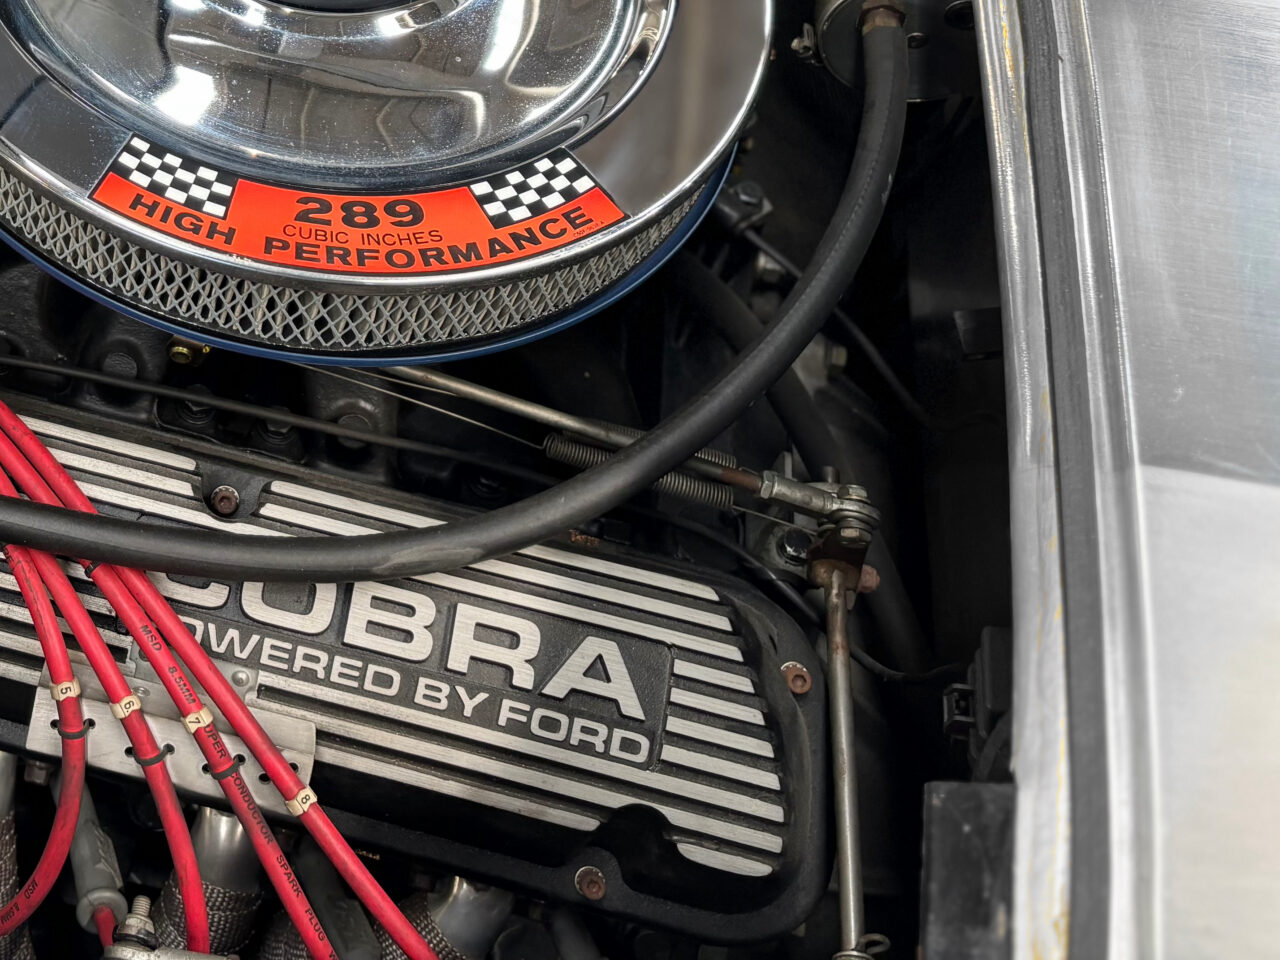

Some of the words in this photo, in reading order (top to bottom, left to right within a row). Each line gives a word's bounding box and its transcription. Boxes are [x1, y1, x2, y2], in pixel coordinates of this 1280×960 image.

[293, 196, 425, 229] 289
[128, 193, 237, 245] HIGH
[263, 205, 594, 268] PERFORMANCE
[282, 224, 350, 244] CUBIC
[361, 229, 443, 246] INCHES
[60, 686, 72, 695] 5
[177, 615, 401, 697] WERED
[413, 676, 490, 718] BY
[498, 698, 650, 763] FORD
[188, 716, 201, 724] 7
[140, 625, 162, 651] MSD
[168, 665, 197, 705] 8.5MM
[204, 724, 227, 759] UPER
[276, 854, 303, 898] SPARK
[305, 908, 326, 942] PLUG
[301, 794, 311, 805] 8
